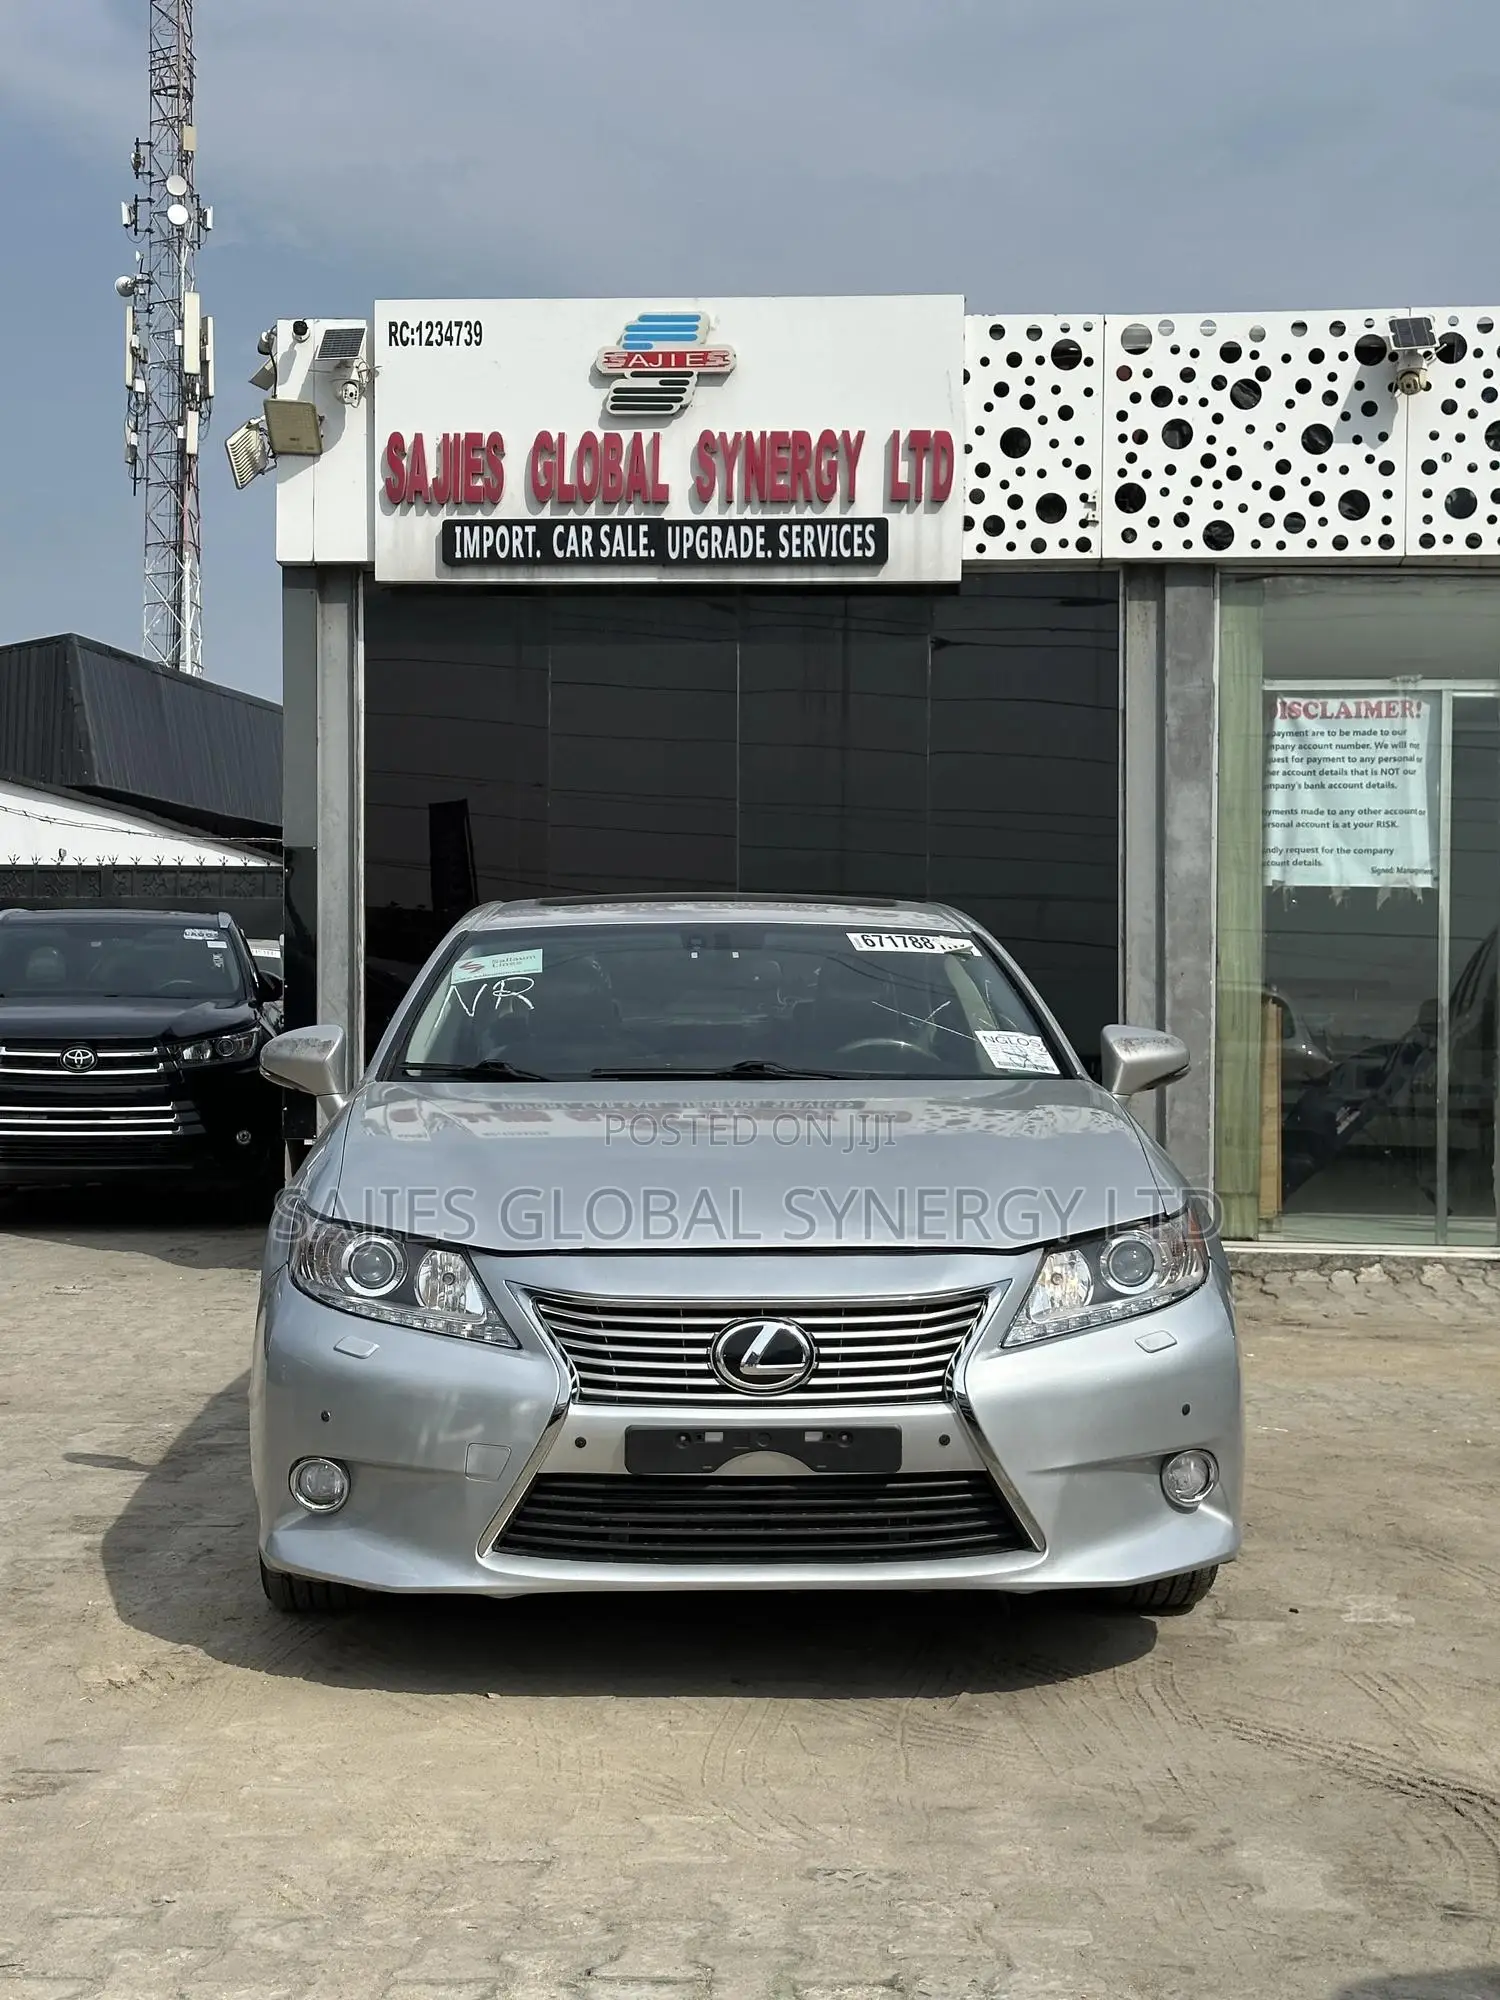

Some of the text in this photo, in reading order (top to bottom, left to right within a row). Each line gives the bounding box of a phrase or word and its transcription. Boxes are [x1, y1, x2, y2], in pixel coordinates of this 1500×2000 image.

[388, 320, 483, 347] RC:1234739
[603, 351, 731, 368] SAJIES
[385, 429, 954, 504] SAJIES GLOBAL SYNERGY LTD
[454, 523, 876, 559] IMPORT. CAR SALE. UPGRADE. SERVICES
[1271, 730, 1309, 739] payment
[1327, 729, 1337, 737] to
[1339, 728, 1351, 737] be
[1352, 728, 1378, 737] made
[1380, 729, 1390, 737] to
[1391, 729, 1408, 737] our
[1335, 742, 1373, 750] number.
[1374, 741, 1389, 750] We
[1391, 741, 1407, 749] will
[1291, 755, 1303, 764] for
[1306, 756, 1346, 765] payment
[1347, 755, 1358, 763] to
[1359, 756, 1376, 765] any
[1378, 755, 1415, 765] personal
[1318, 768, 1348, 776] details
[1350, 768, 1369, 776] that
[1371, 768, 1378, 776] is
[1380, 768, 1400, 776] NOT
[1303, 781, 1326, 790] bank
[1327, 782, 1364, 790] account
[1301, 808, 1325, 816] made
[1327, 808, 1337, 816] to
[1338, 809, 1355, 817] any
[1357, 807, 1382, 816] other
[1384, 808, 1417, 816] account
[1332, 820, 1340, 829] is
[1341, 821, 1351, 829] at
[1353, 821, 1374, 830] your
[1285, 847, 1319, 855] request
[1321, 846, 1334, 855] for
[1336, 847, 1351, 855] the
[1353, 848, 1395, 856] company
[860, 934, 935, 950] 671788
